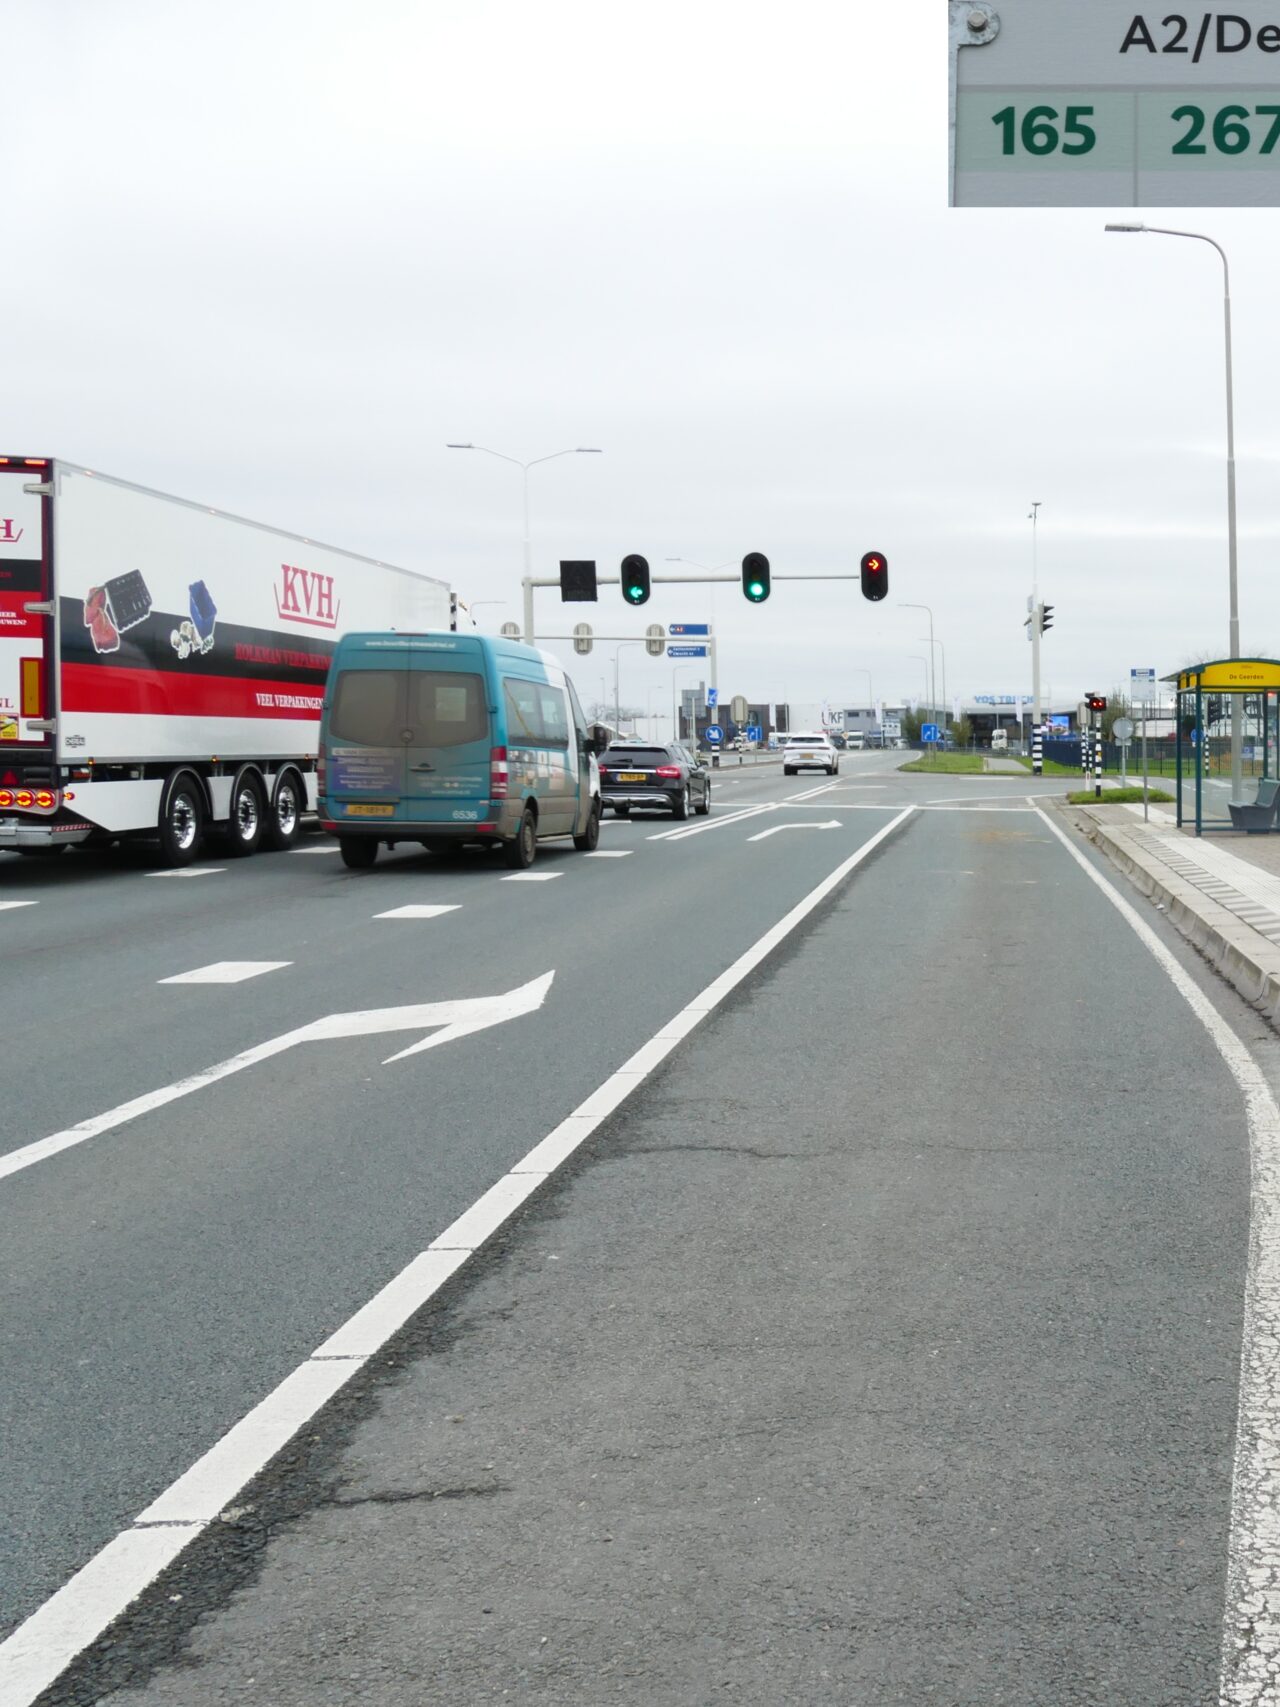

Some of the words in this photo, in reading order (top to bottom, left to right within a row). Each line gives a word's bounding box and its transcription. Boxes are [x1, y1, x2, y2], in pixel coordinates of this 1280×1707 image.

[990, 105, 1097, 156] 165
[281, 564, 334, 619] KVH
[256, 692, 274, 707] VEEL
[452, 810, 478, 820] 6536
